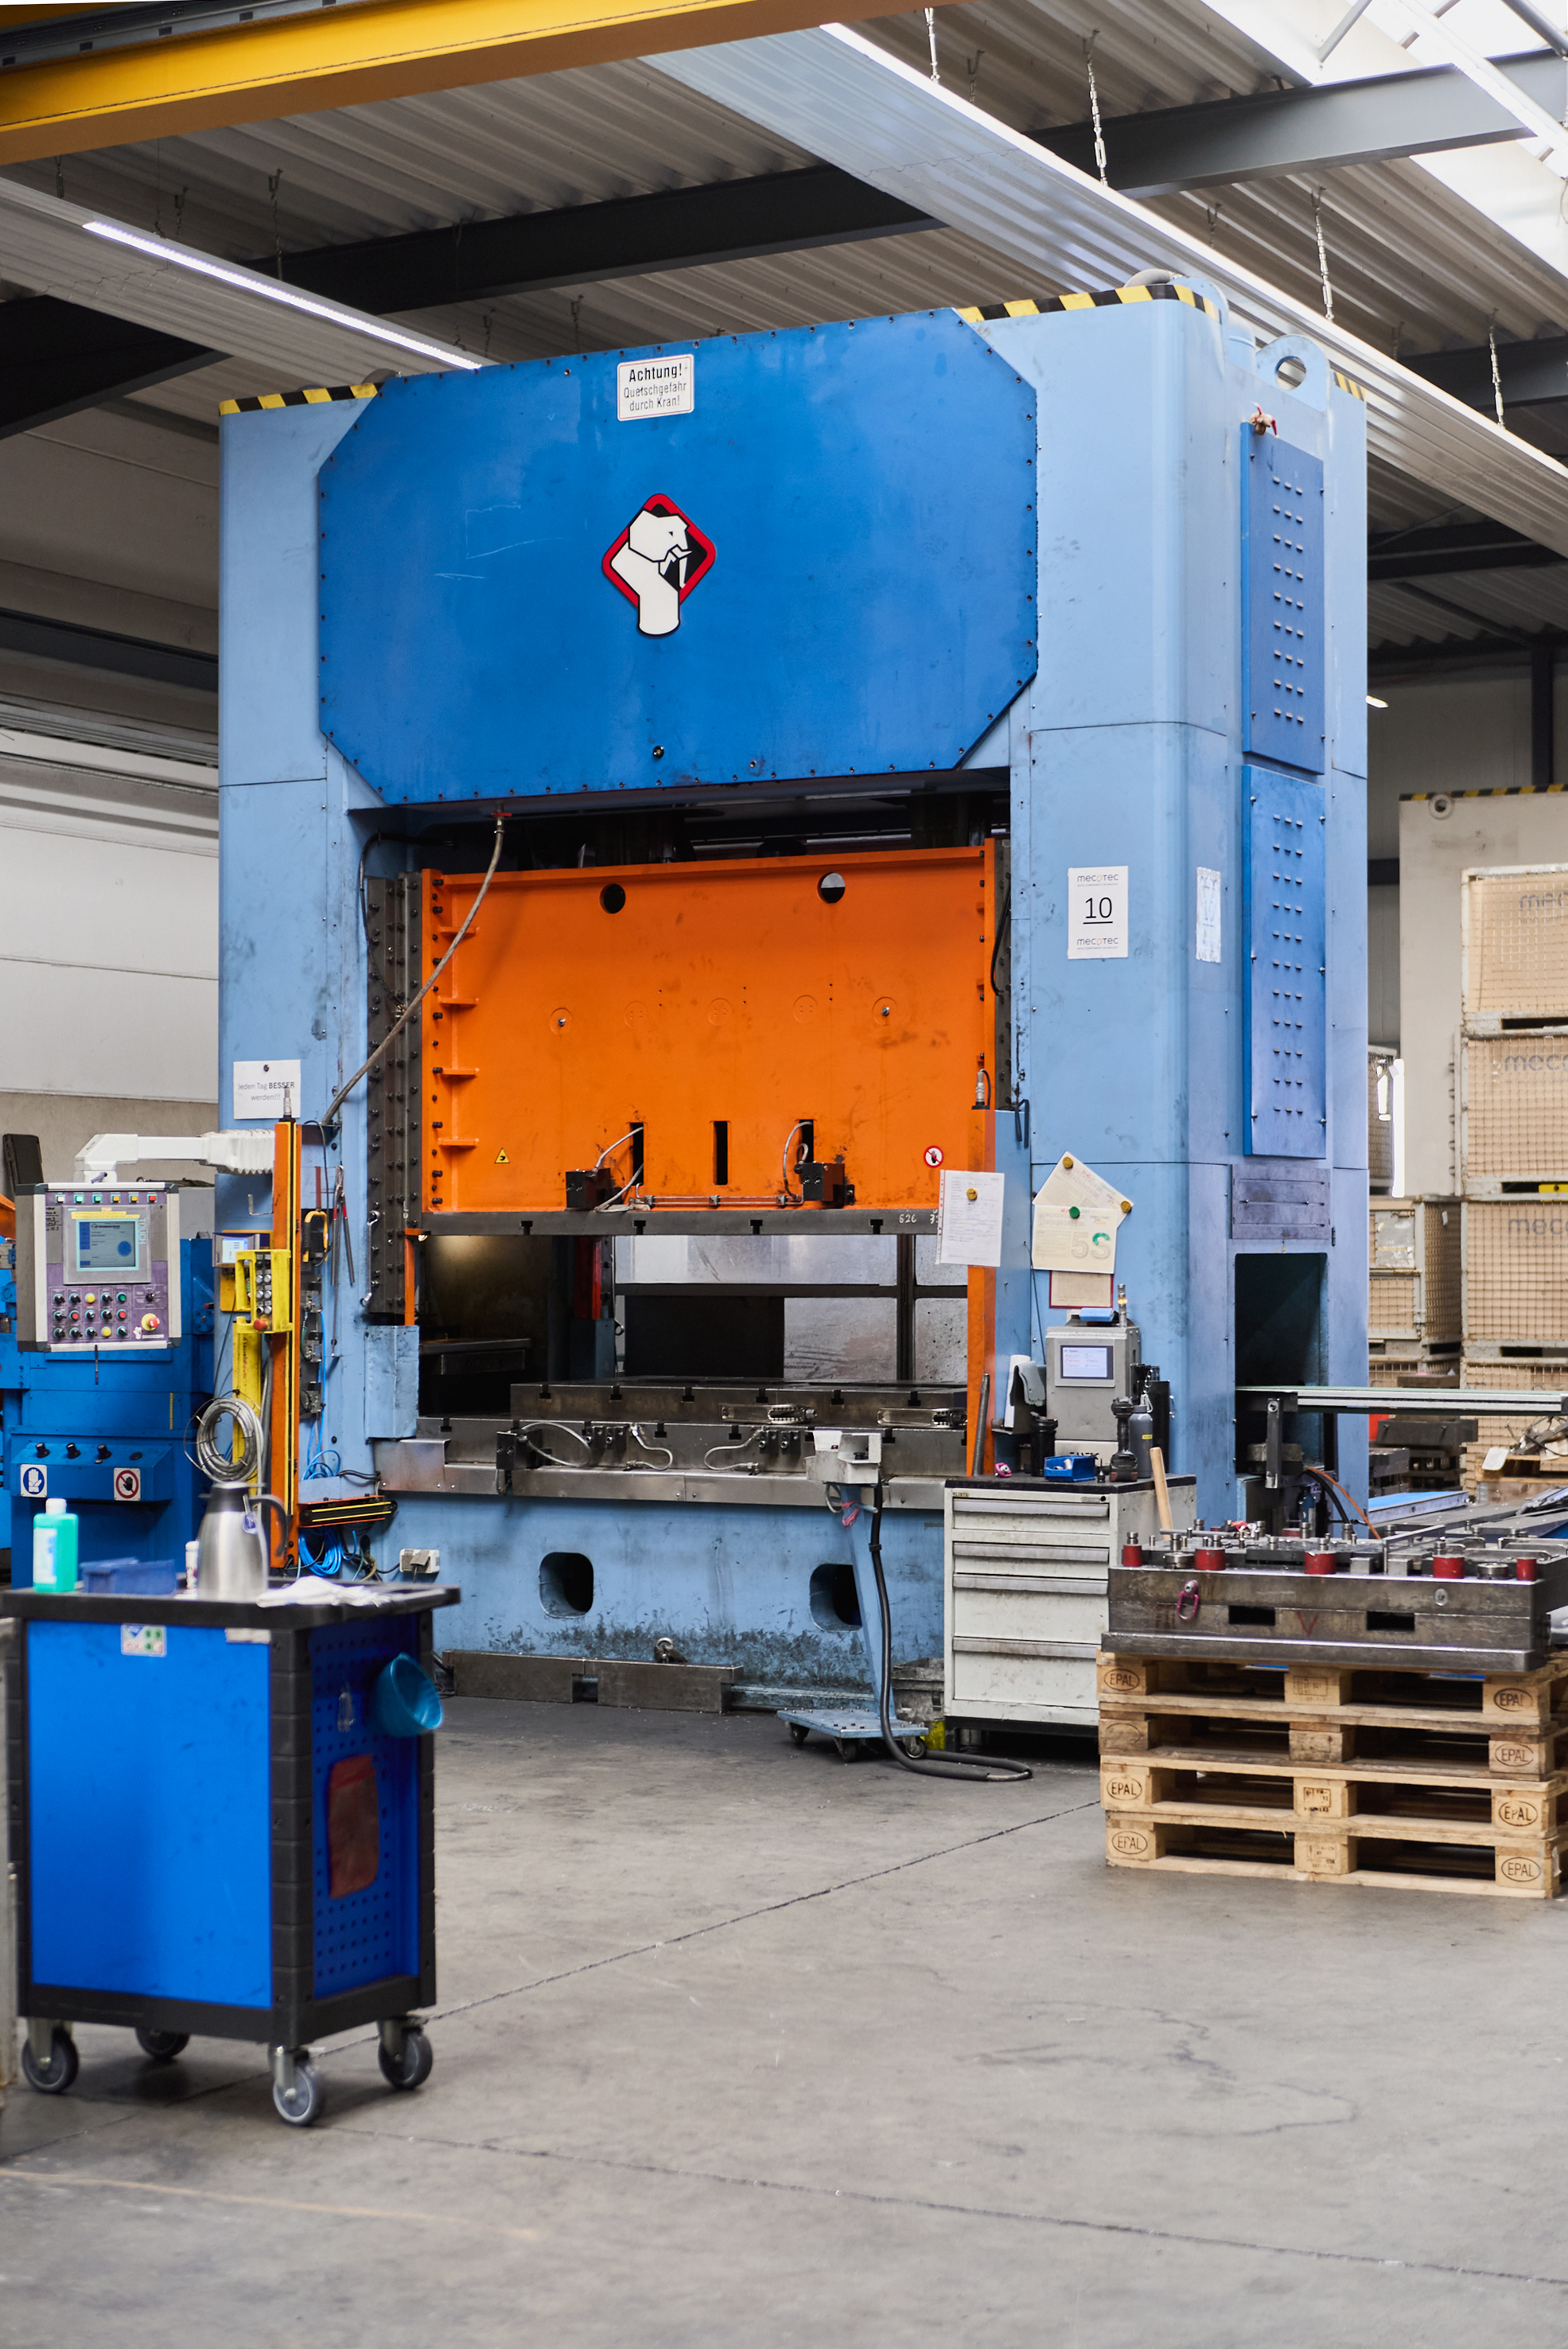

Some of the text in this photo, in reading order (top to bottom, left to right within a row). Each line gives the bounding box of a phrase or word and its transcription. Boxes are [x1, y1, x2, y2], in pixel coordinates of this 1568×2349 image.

[628, 363, 682, 383] Achtung!
[623, 381, 687, 399] Quetschgefahr
[629, 395, 680, 411] durch Kran!
[1084, 897, 1113, 919] 10
[257, 1082, 267, 1091] Tag
[1071, 1231, 1111, 1260] 5S
[1110, 1673, 1135, 1687] EPAL
[1501, 1748, 1529, 1763] EPAL
[1111, 1782, 1138, 1796] EPAL
[1504, 1806, 1532, 1821] EPAL
[1117, 1835, 1142, 1850] EPAL
[1508, 1862, 1535, 1877] EPAL
